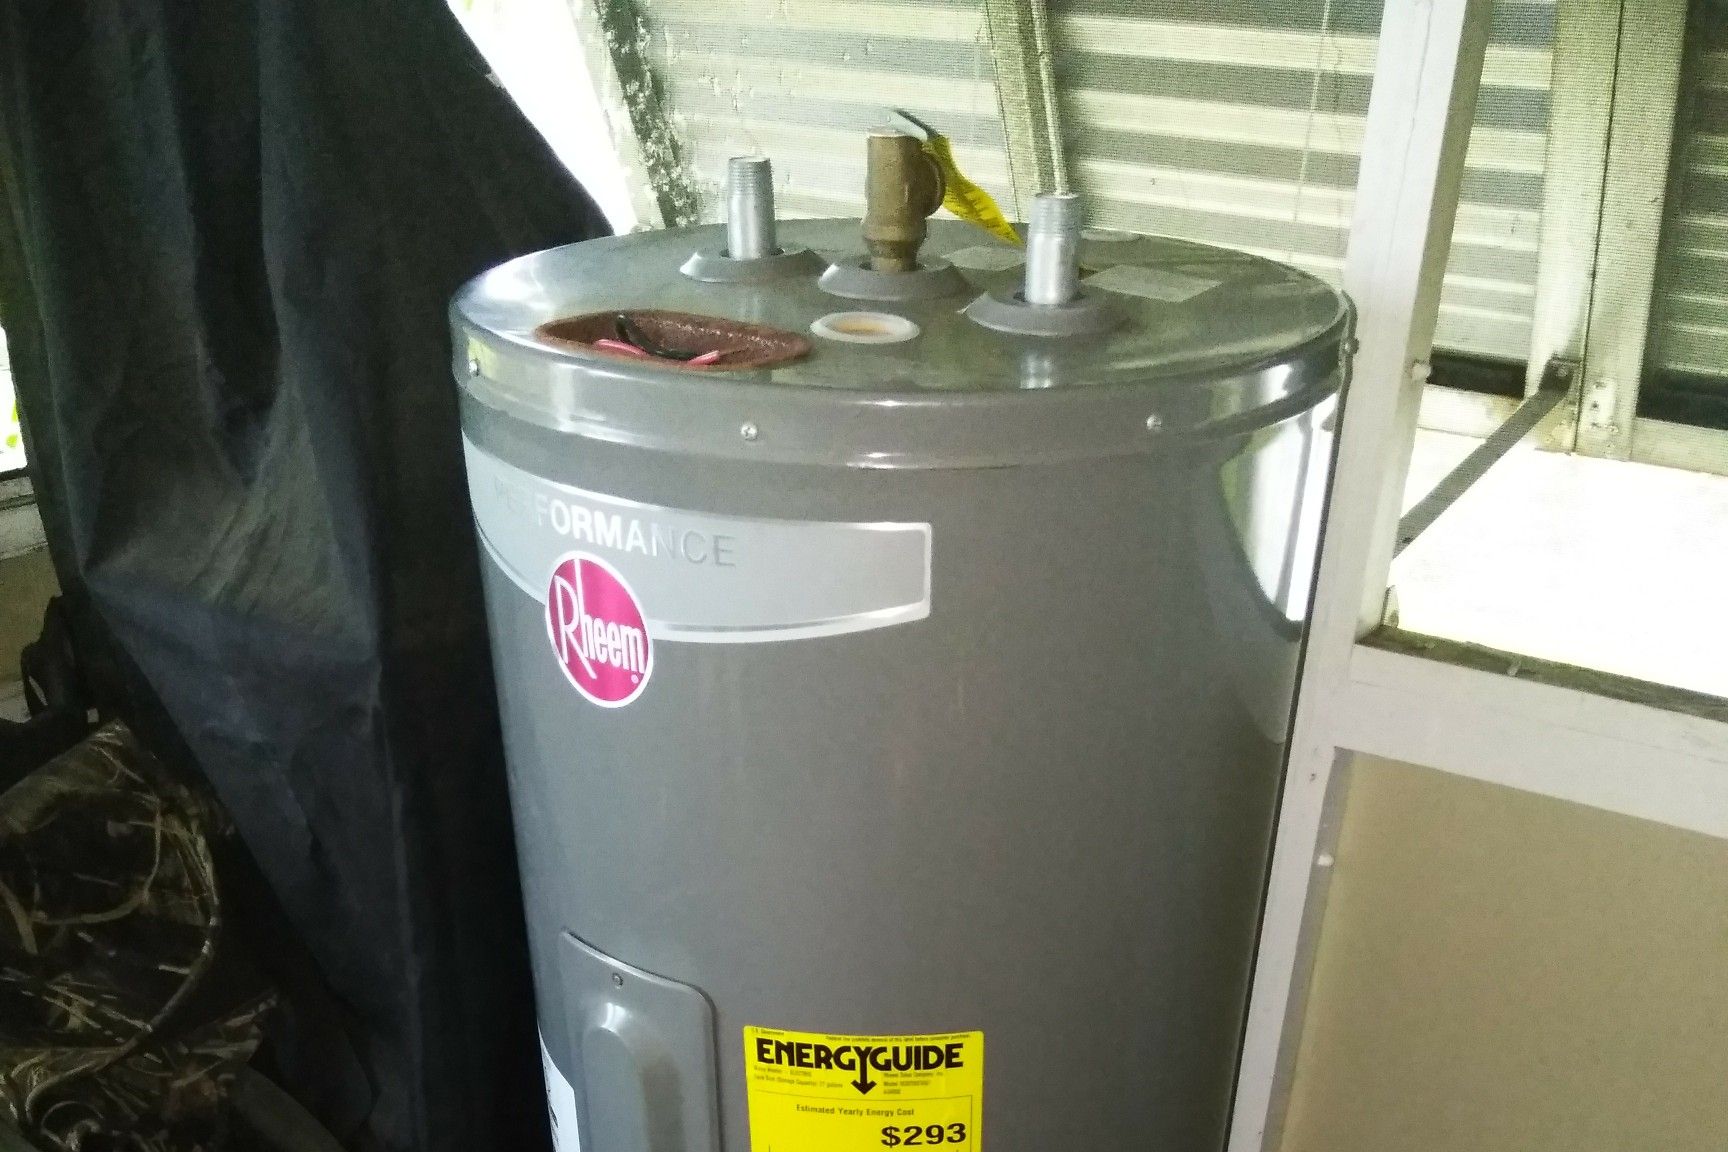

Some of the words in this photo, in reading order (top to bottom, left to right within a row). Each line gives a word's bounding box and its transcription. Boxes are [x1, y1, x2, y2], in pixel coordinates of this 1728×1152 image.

[554, 559, 646, 680] Rheem
[756, 1037, 964, 1072] ENERGYGUIDE
[796, 1104, 835, 1114] Estimated
[838, 1107, 863, 1116] Yearly
[866, 1109, 894, 1117] Energy
[897, 1108, 914, 1116] Cost
[881, 1122, 966, 1149] $293
